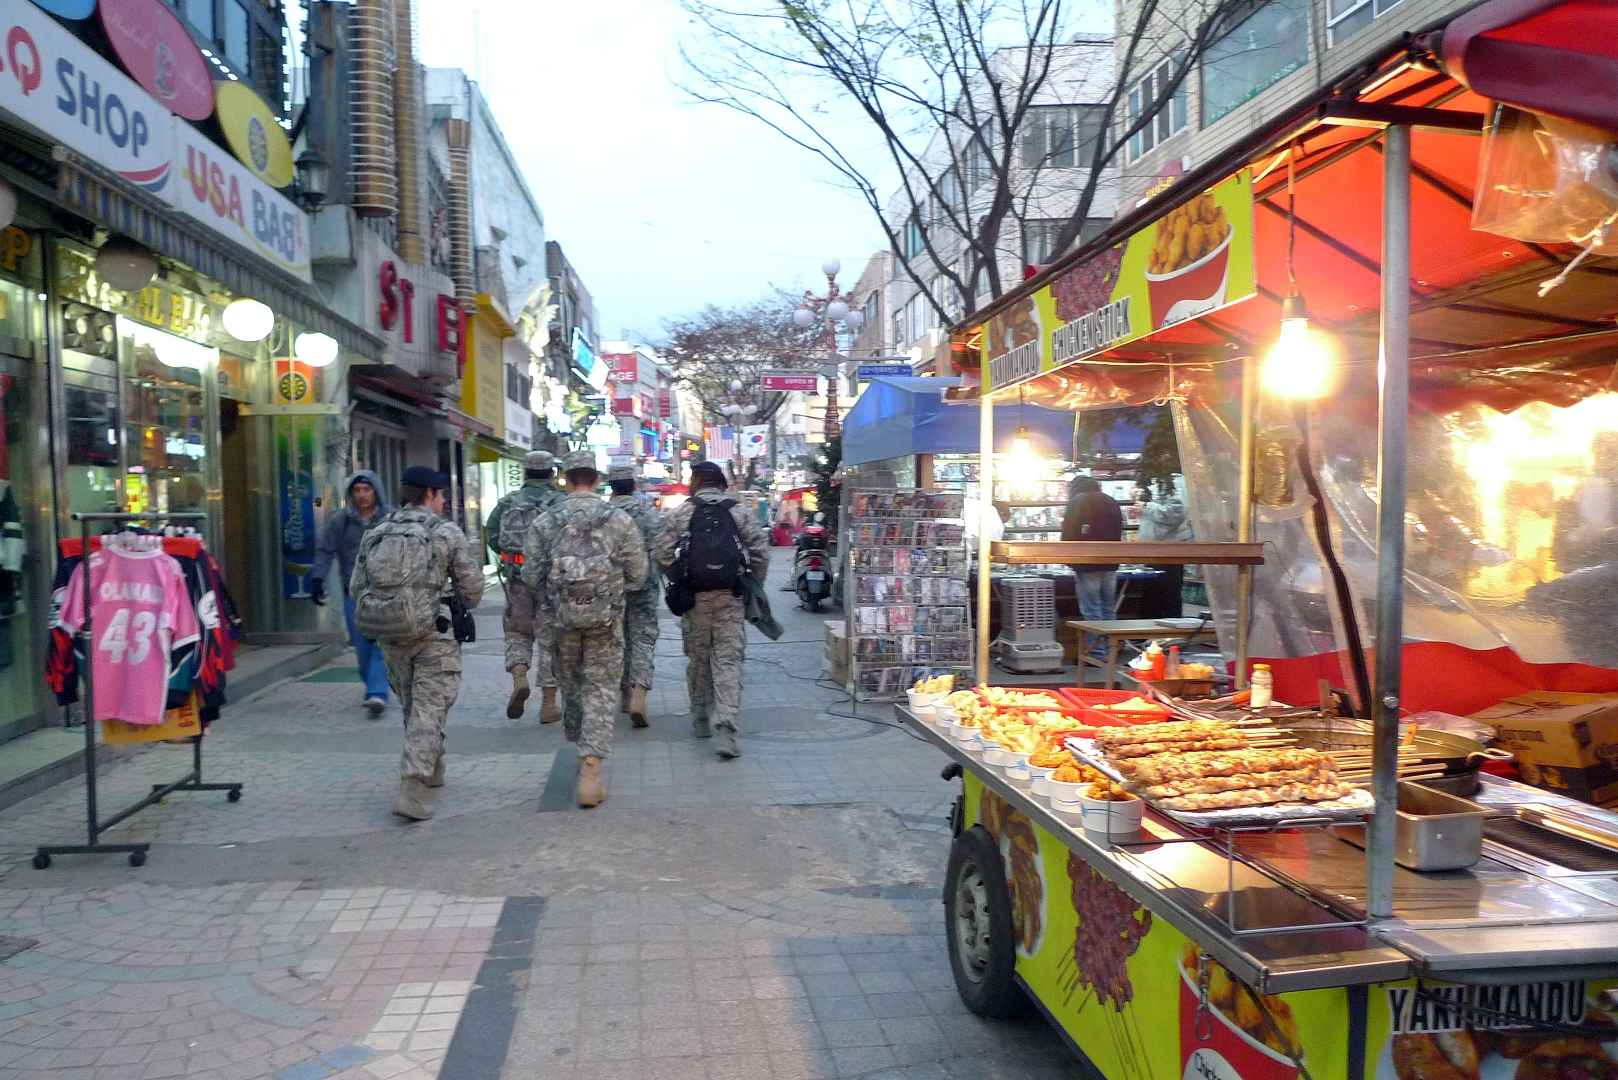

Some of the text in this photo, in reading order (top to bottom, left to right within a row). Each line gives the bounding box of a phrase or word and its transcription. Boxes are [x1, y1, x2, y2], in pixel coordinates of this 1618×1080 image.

[56, 57, 149, 158] SHOP
[187, 144, 245, 228] USA
[1095, 295, 1132, 347] STICK
[99, 608, 157, 666] 43
[1388, 979, 1586, 1032] YAKI MANDU
